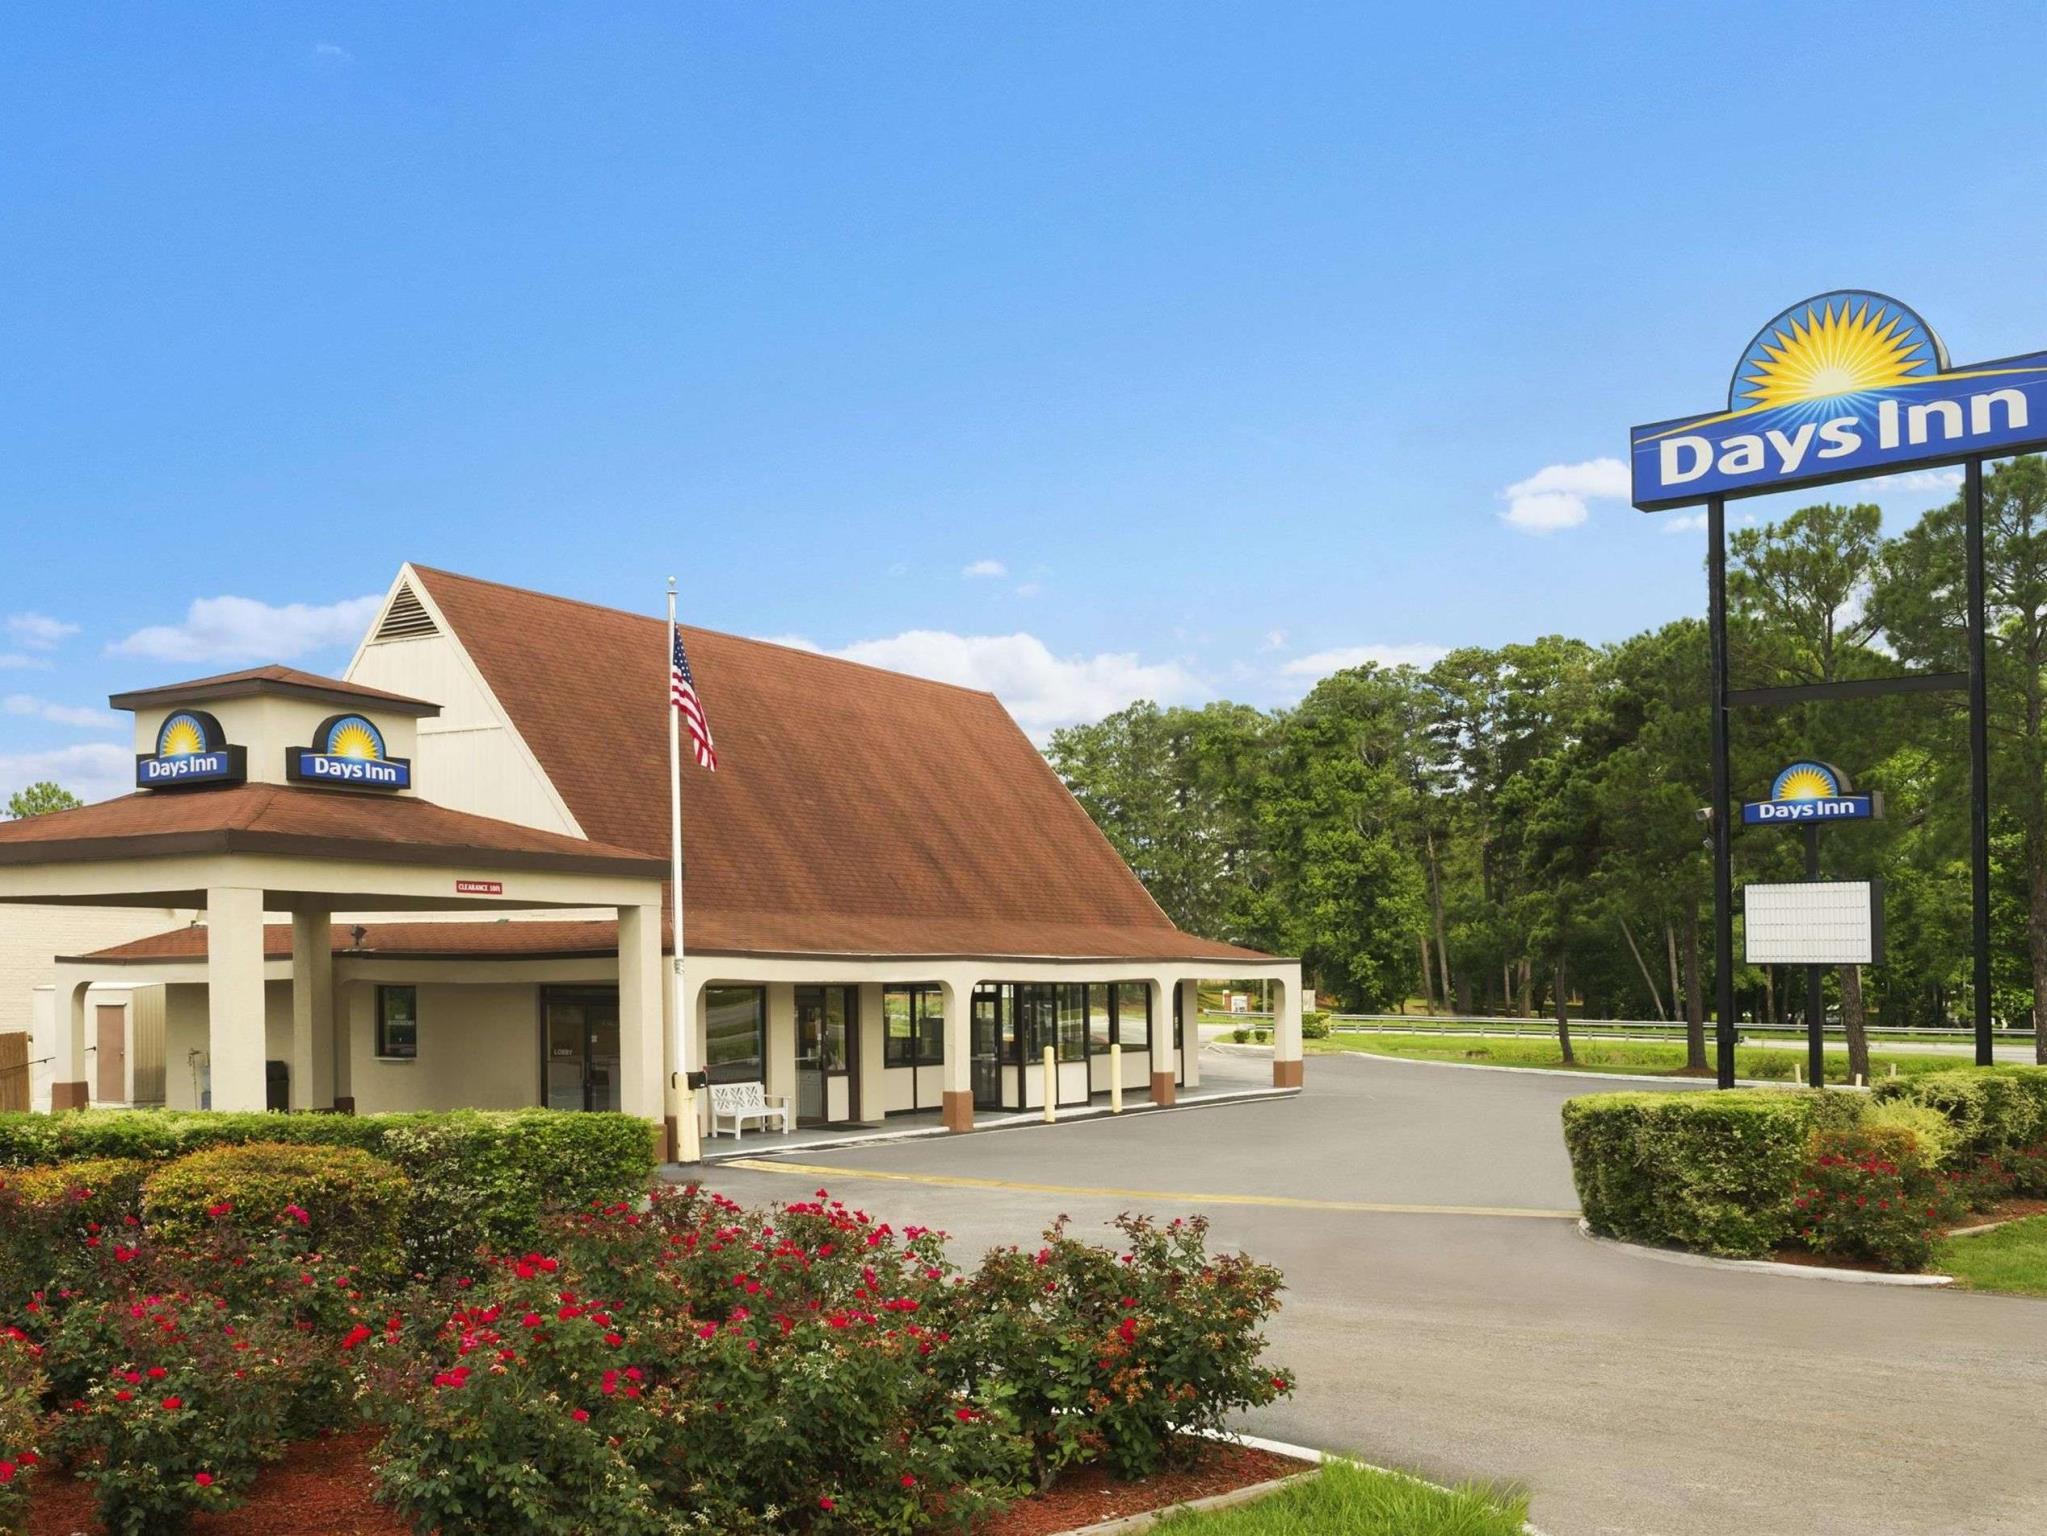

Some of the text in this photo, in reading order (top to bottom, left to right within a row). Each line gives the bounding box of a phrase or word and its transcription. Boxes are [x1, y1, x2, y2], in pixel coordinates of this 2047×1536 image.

[1660, 388, 2029, 486] Days Inn
[149, 756, 217, 777] Days Inn
[315, 757, 396, 781] Days Inn
[1759, 801, 1854, 819] Days Inn
